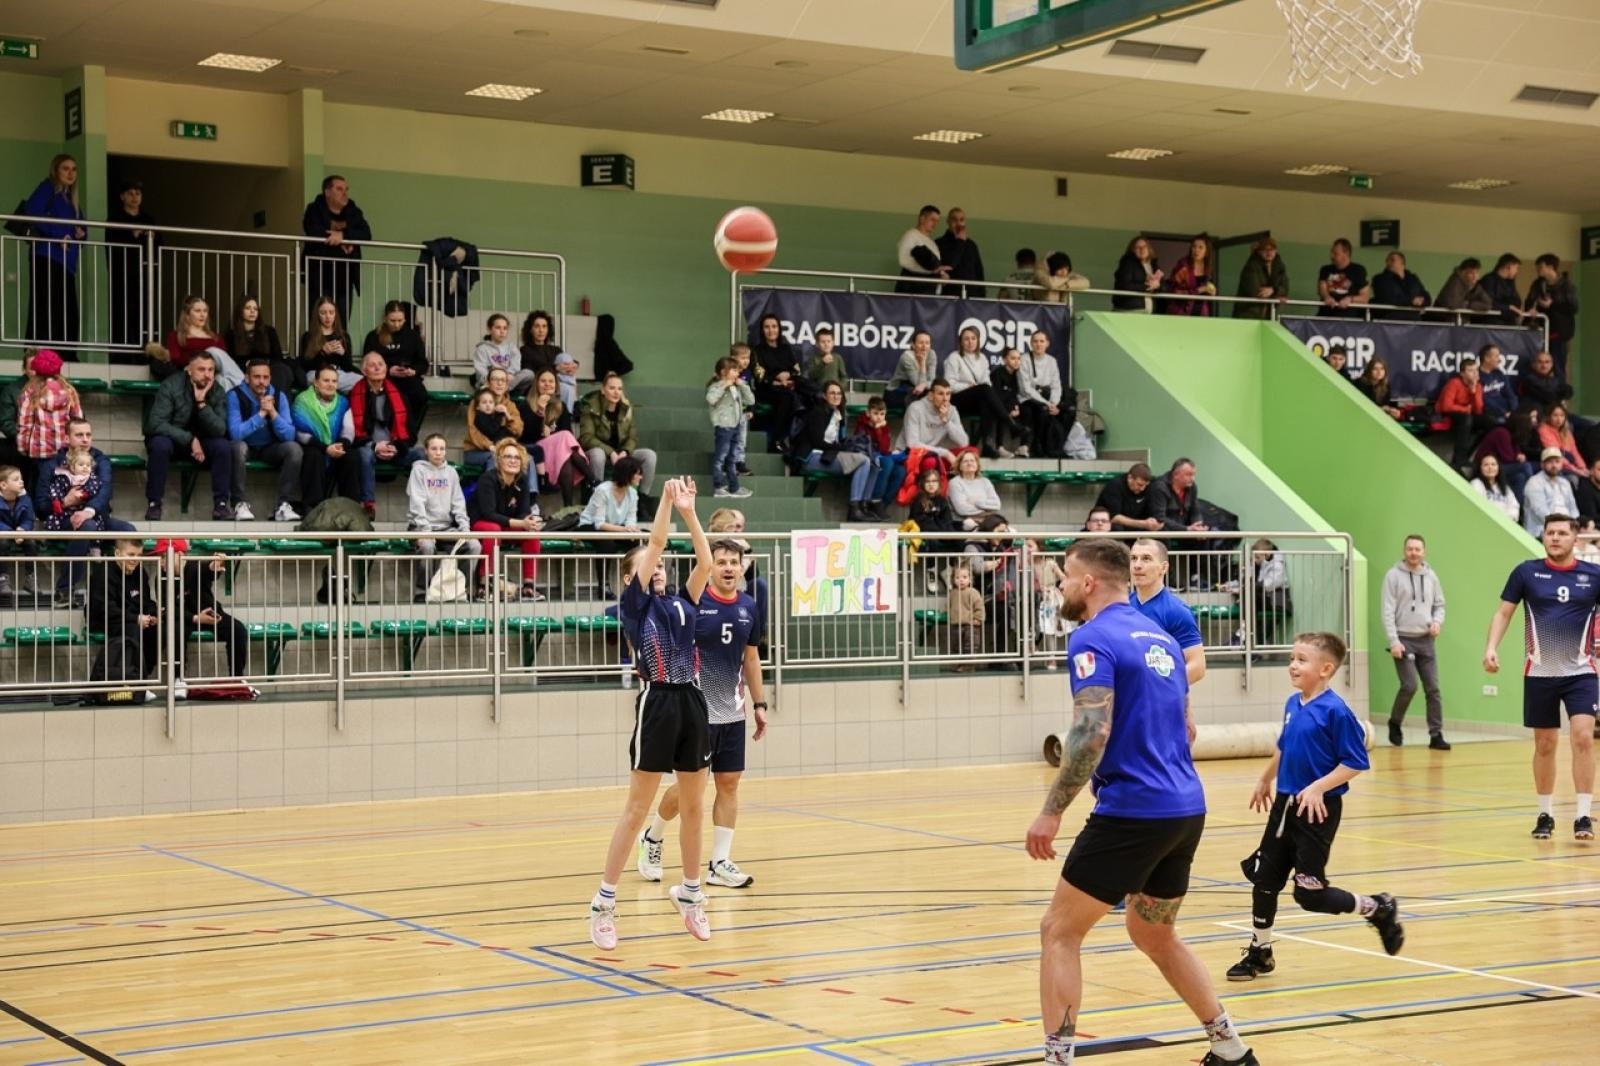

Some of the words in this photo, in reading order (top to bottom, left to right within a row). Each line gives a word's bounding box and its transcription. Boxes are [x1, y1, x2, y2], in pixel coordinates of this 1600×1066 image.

[593, 165, 612, 183] E
[1372, 229, 1389, 244] F
[797, 535, 893, 578] TEAM
[793, 577, 890, 614] MAJKEL
[1557, 585, 1570, 603] 9
[673, 601, 686, 626] 1
[721, 623, 733, 645] 5
